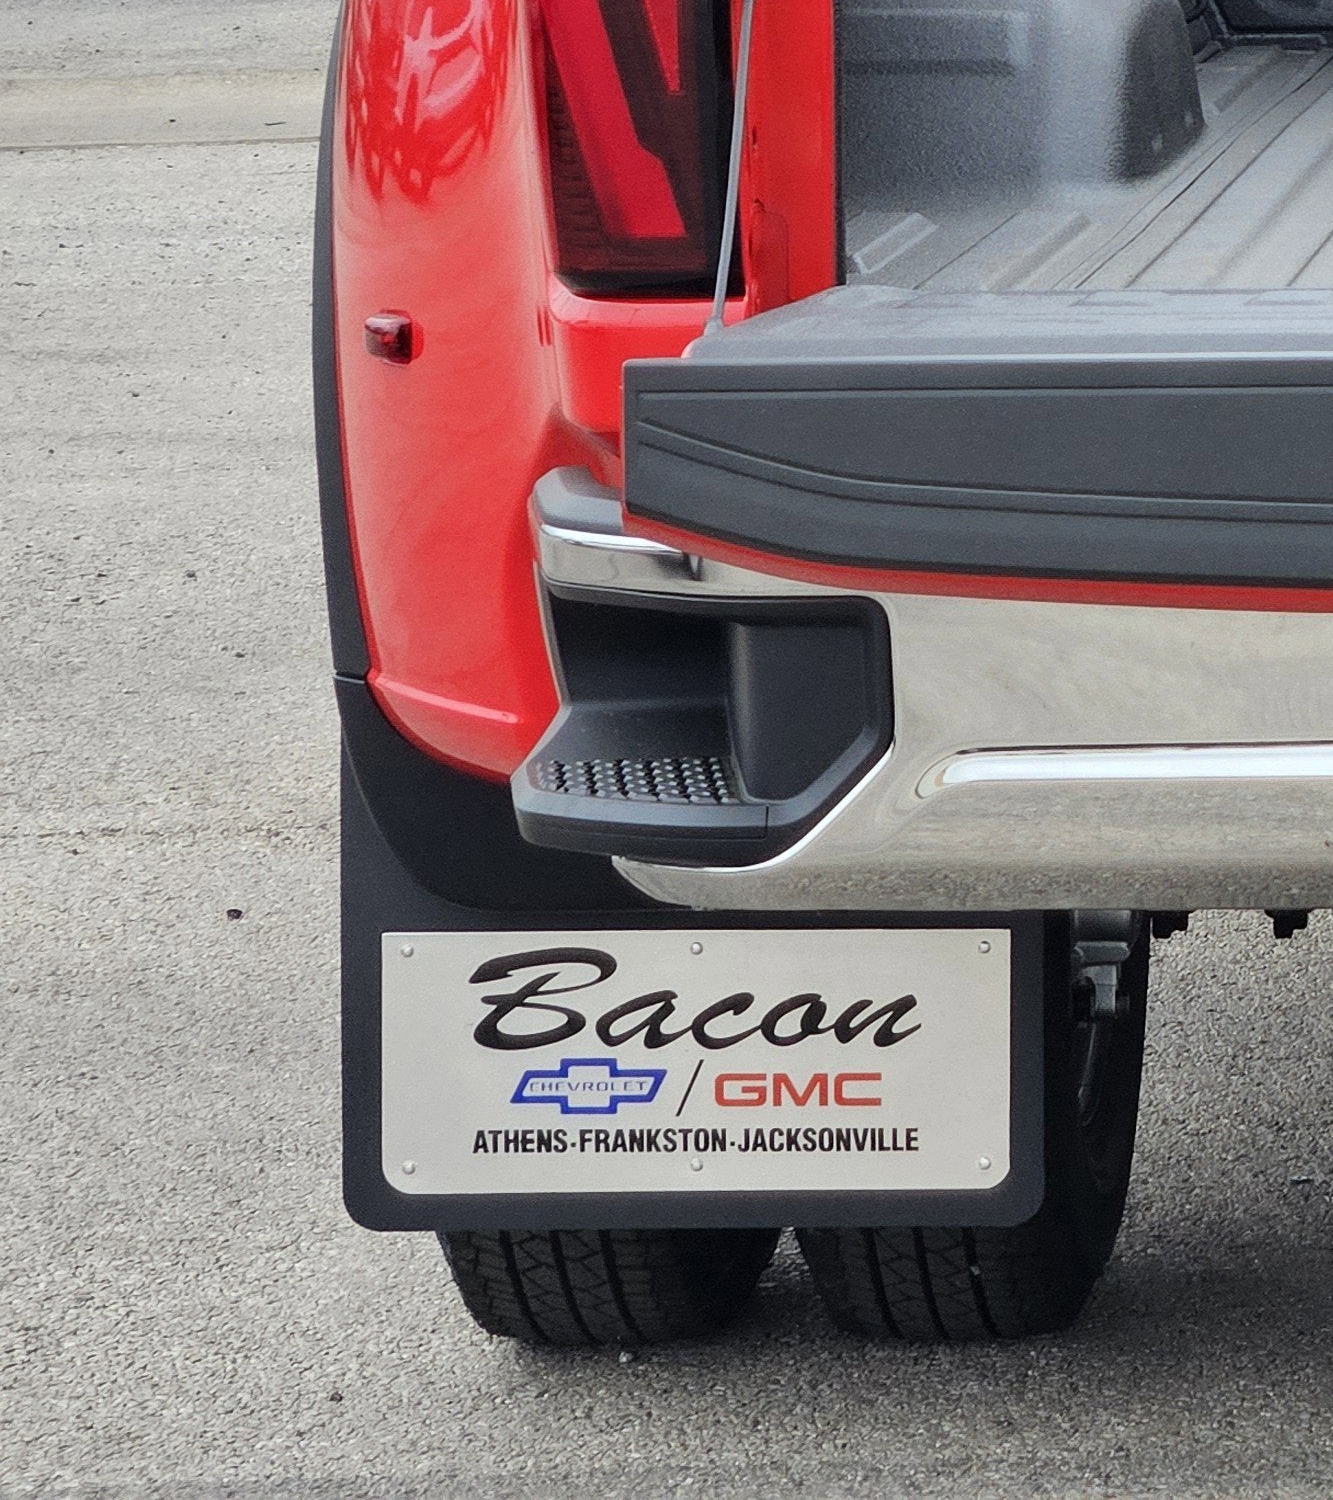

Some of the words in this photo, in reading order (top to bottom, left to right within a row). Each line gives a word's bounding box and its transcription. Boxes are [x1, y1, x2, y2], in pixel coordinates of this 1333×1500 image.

[468, 946, 922, 1051] Bacon
[529, 1079, 649, 1093] CHEVROLET
[714, 1072, 883, 1107] GMC
